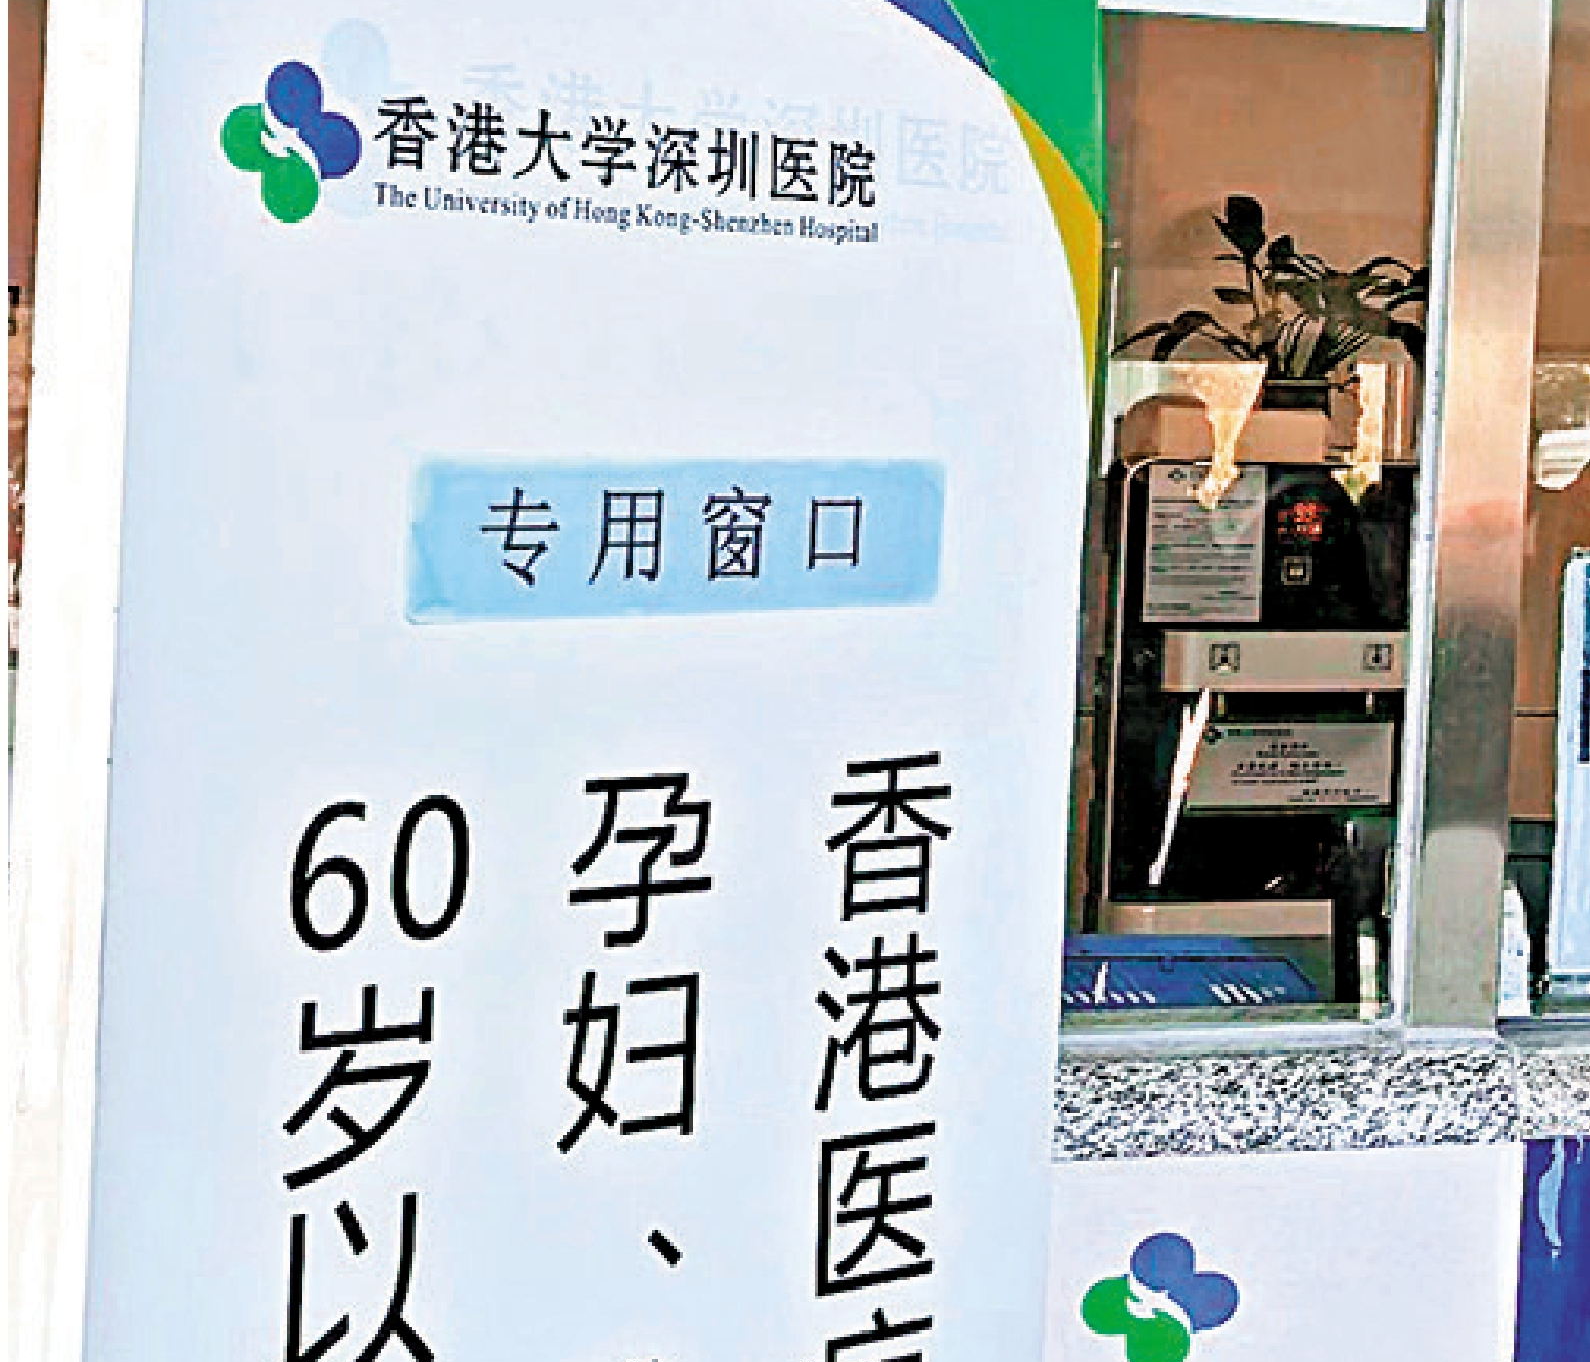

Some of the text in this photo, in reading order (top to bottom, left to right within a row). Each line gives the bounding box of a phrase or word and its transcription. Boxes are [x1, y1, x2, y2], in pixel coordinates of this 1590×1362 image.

[372, 96, 875, 208] 香港大学深圳医院
[375, 181, 878, 245] The University of Hong Kong-Shenzhen Hospital
[479, 484, 862, 588] 专用窗口
